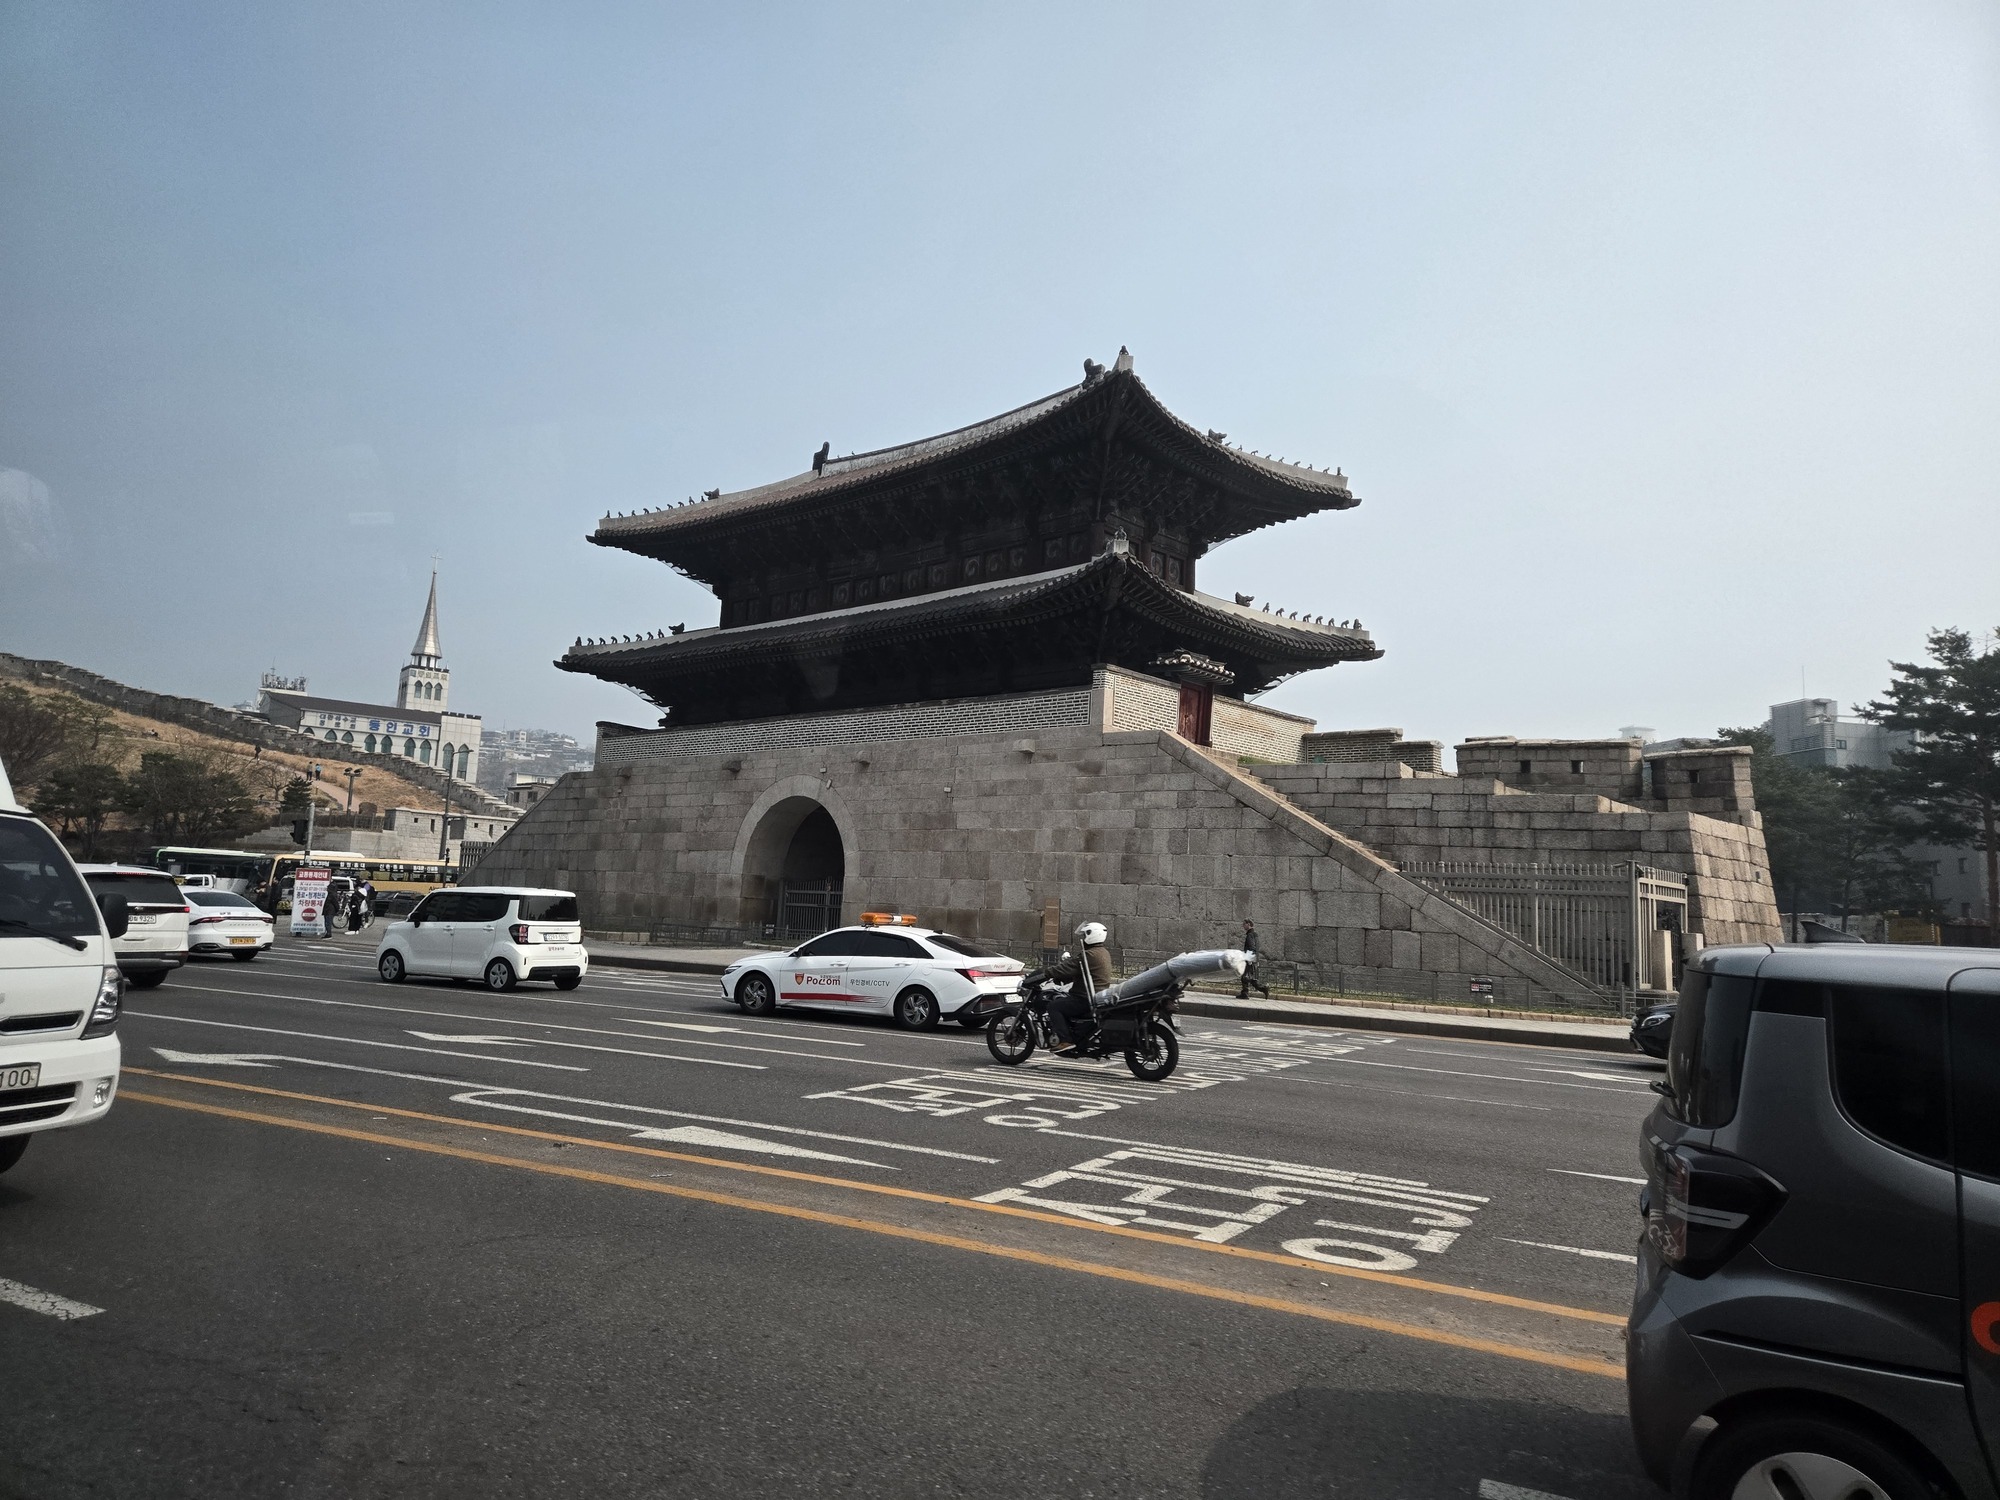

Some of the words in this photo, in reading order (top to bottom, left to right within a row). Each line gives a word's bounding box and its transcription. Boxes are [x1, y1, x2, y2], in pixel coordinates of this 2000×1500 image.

[298, 871, 328, 879] 교통통제안내
[298, 899, 323, 907] 차량통제
[971, 1147, 1491, 1271] 종로5가
